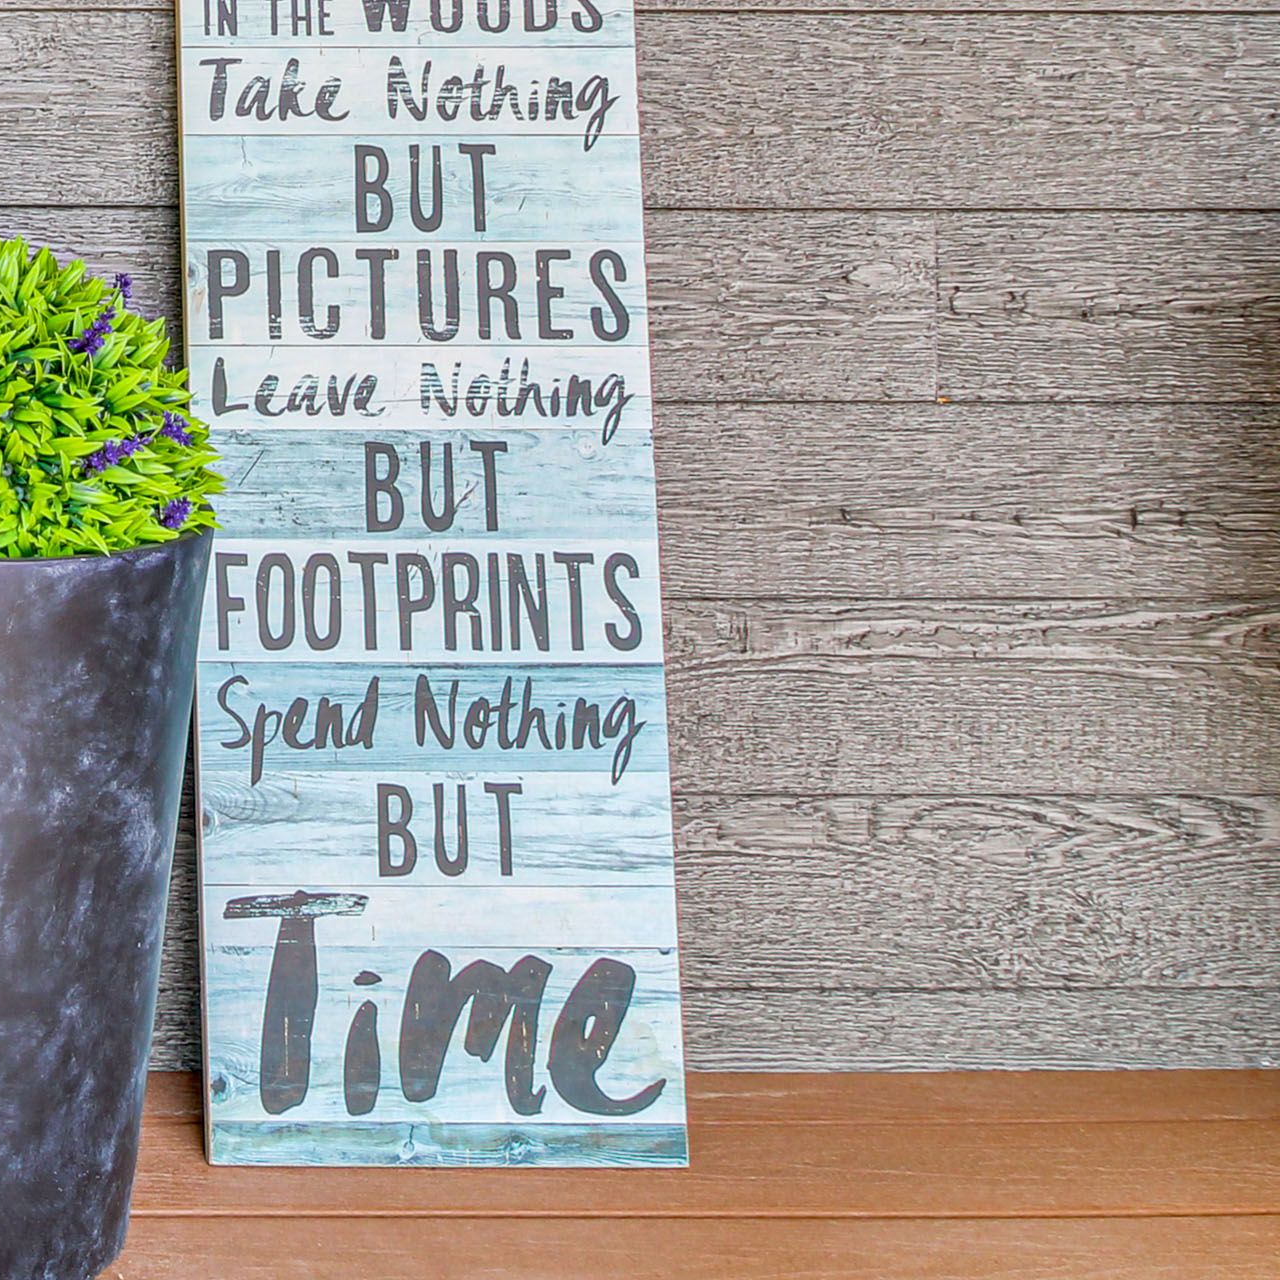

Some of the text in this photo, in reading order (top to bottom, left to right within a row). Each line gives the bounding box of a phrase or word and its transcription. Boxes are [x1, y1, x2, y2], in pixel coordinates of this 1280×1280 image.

[198, 55, 621, 152] Take Nothing
[354, 143, 497, 234] BUT
[206, 246, 631, 342] PICTURES
[212, 356, 635, 446] Leave Nothing
[364, 440, 508, 533] BUT
[214, 551, 644, 653] FOOTPRINTS
[216, 673, 647, 787] Spend Nothing
[375, 782, 523, 878] BUT
[222, 889, 668, 1117] Time
